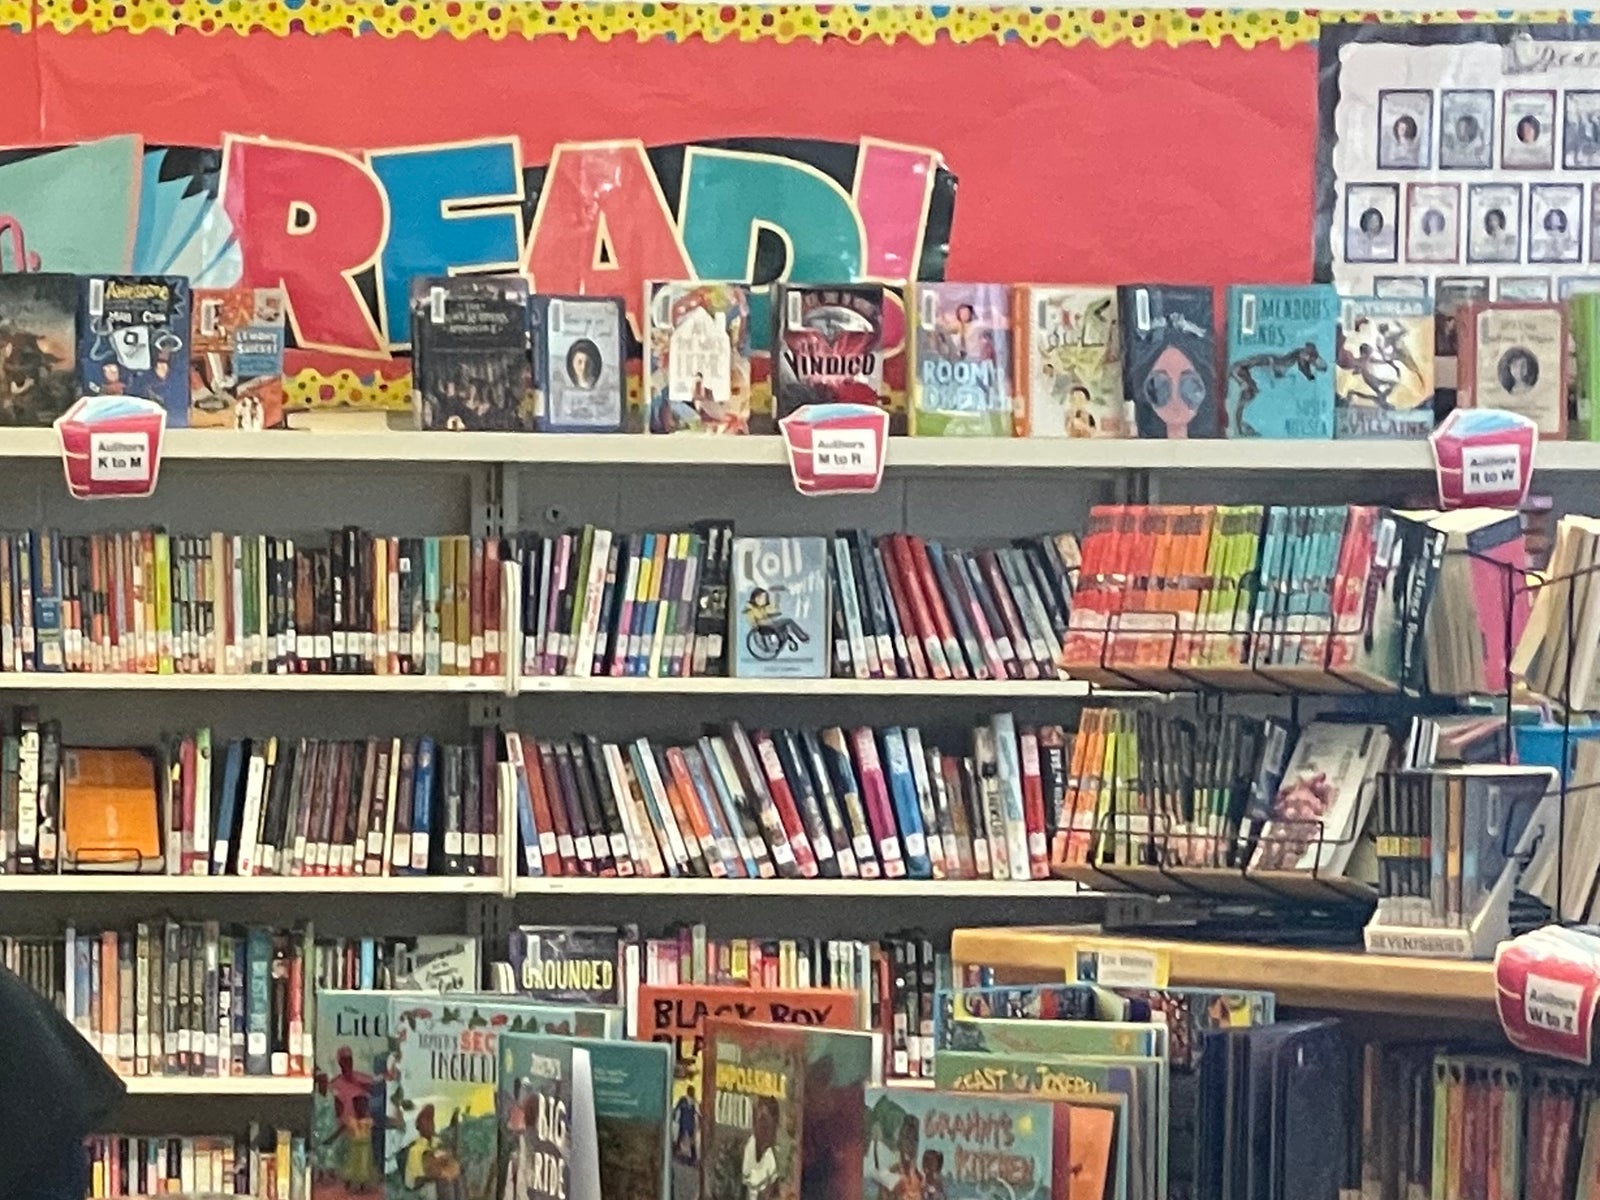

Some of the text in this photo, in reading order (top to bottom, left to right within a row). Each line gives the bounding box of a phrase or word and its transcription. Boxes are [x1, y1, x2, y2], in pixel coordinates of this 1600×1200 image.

[783, 352, 875, 379] VINDICO
[99, 457, 142, 468] K to M
[818, 454, 830, 465] M
[833, 453, 848, 465] to
[1484, 471, 1498, 484] to
[1501, 468, 1515, 482] W
[522, 958, 614, 990] GROUNDED
[1529, 1006, 1543, 1022] W
[1546, 1011, 1561, 1027] to
[460, 1030, 497, 1054] SEC
[431, 1050, 497, 1083] INGREDI
[538, 1092, 566, 1148] BIG
[534, 1152, 566, 1200] RIDE
